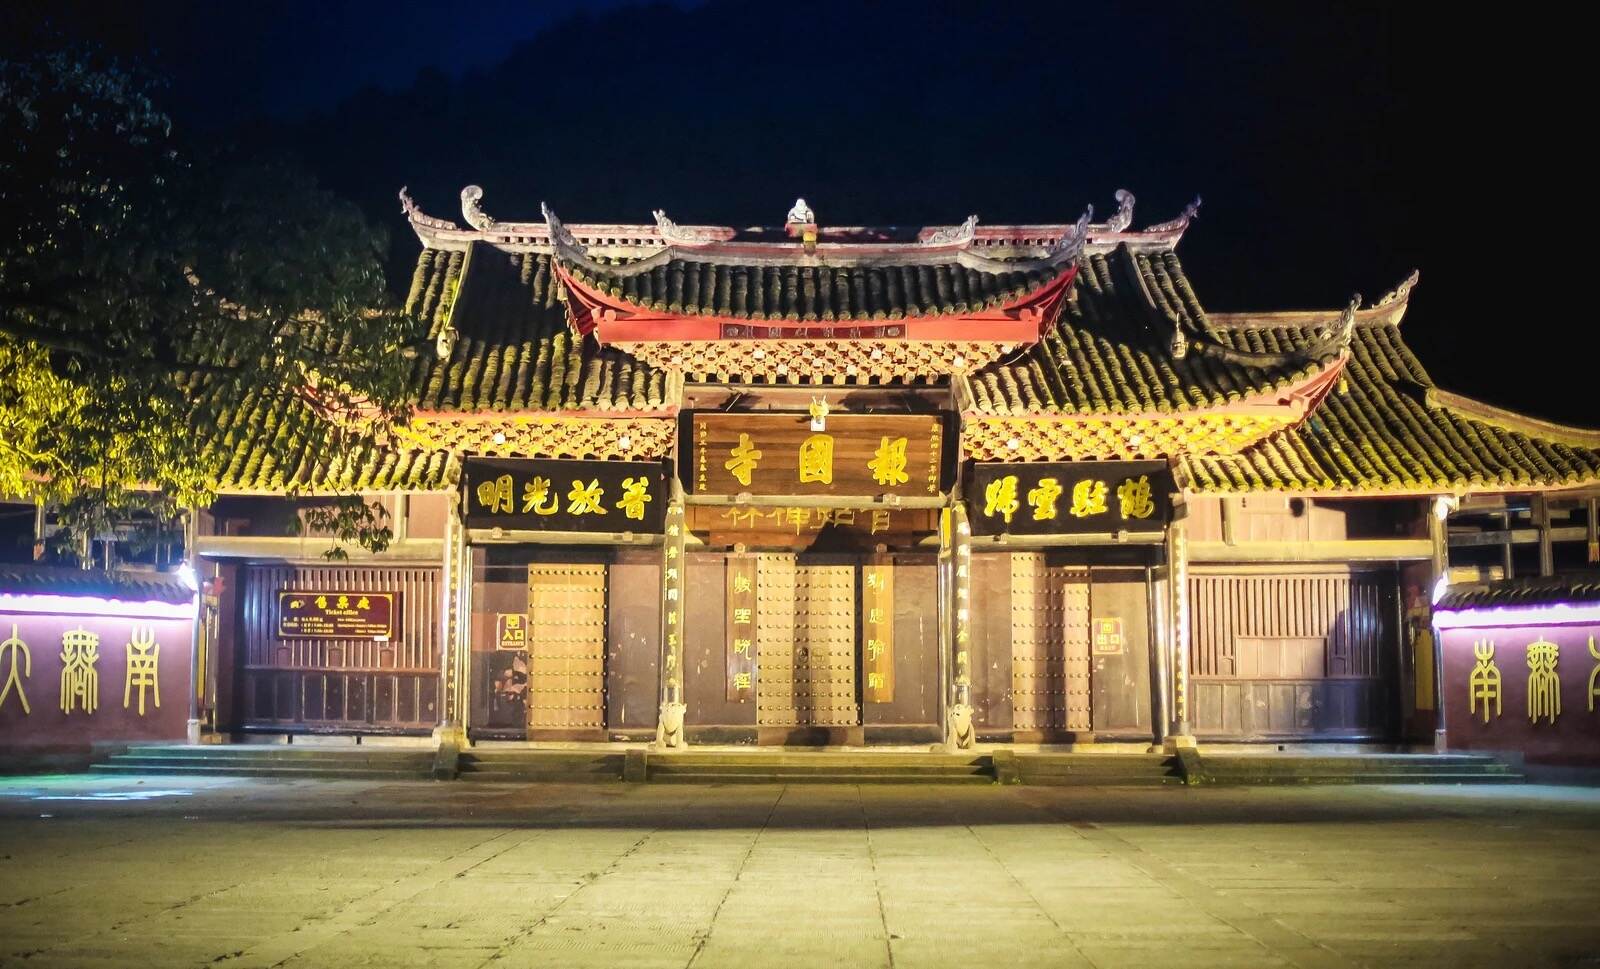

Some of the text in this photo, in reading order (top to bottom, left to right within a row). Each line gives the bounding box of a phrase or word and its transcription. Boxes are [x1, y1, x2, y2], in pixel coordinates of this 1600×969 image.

[724, 432, 909, 487] 報國寺
[477, 474, 653, 521] 普放光明
[502, 629, 524, 641] 入口
